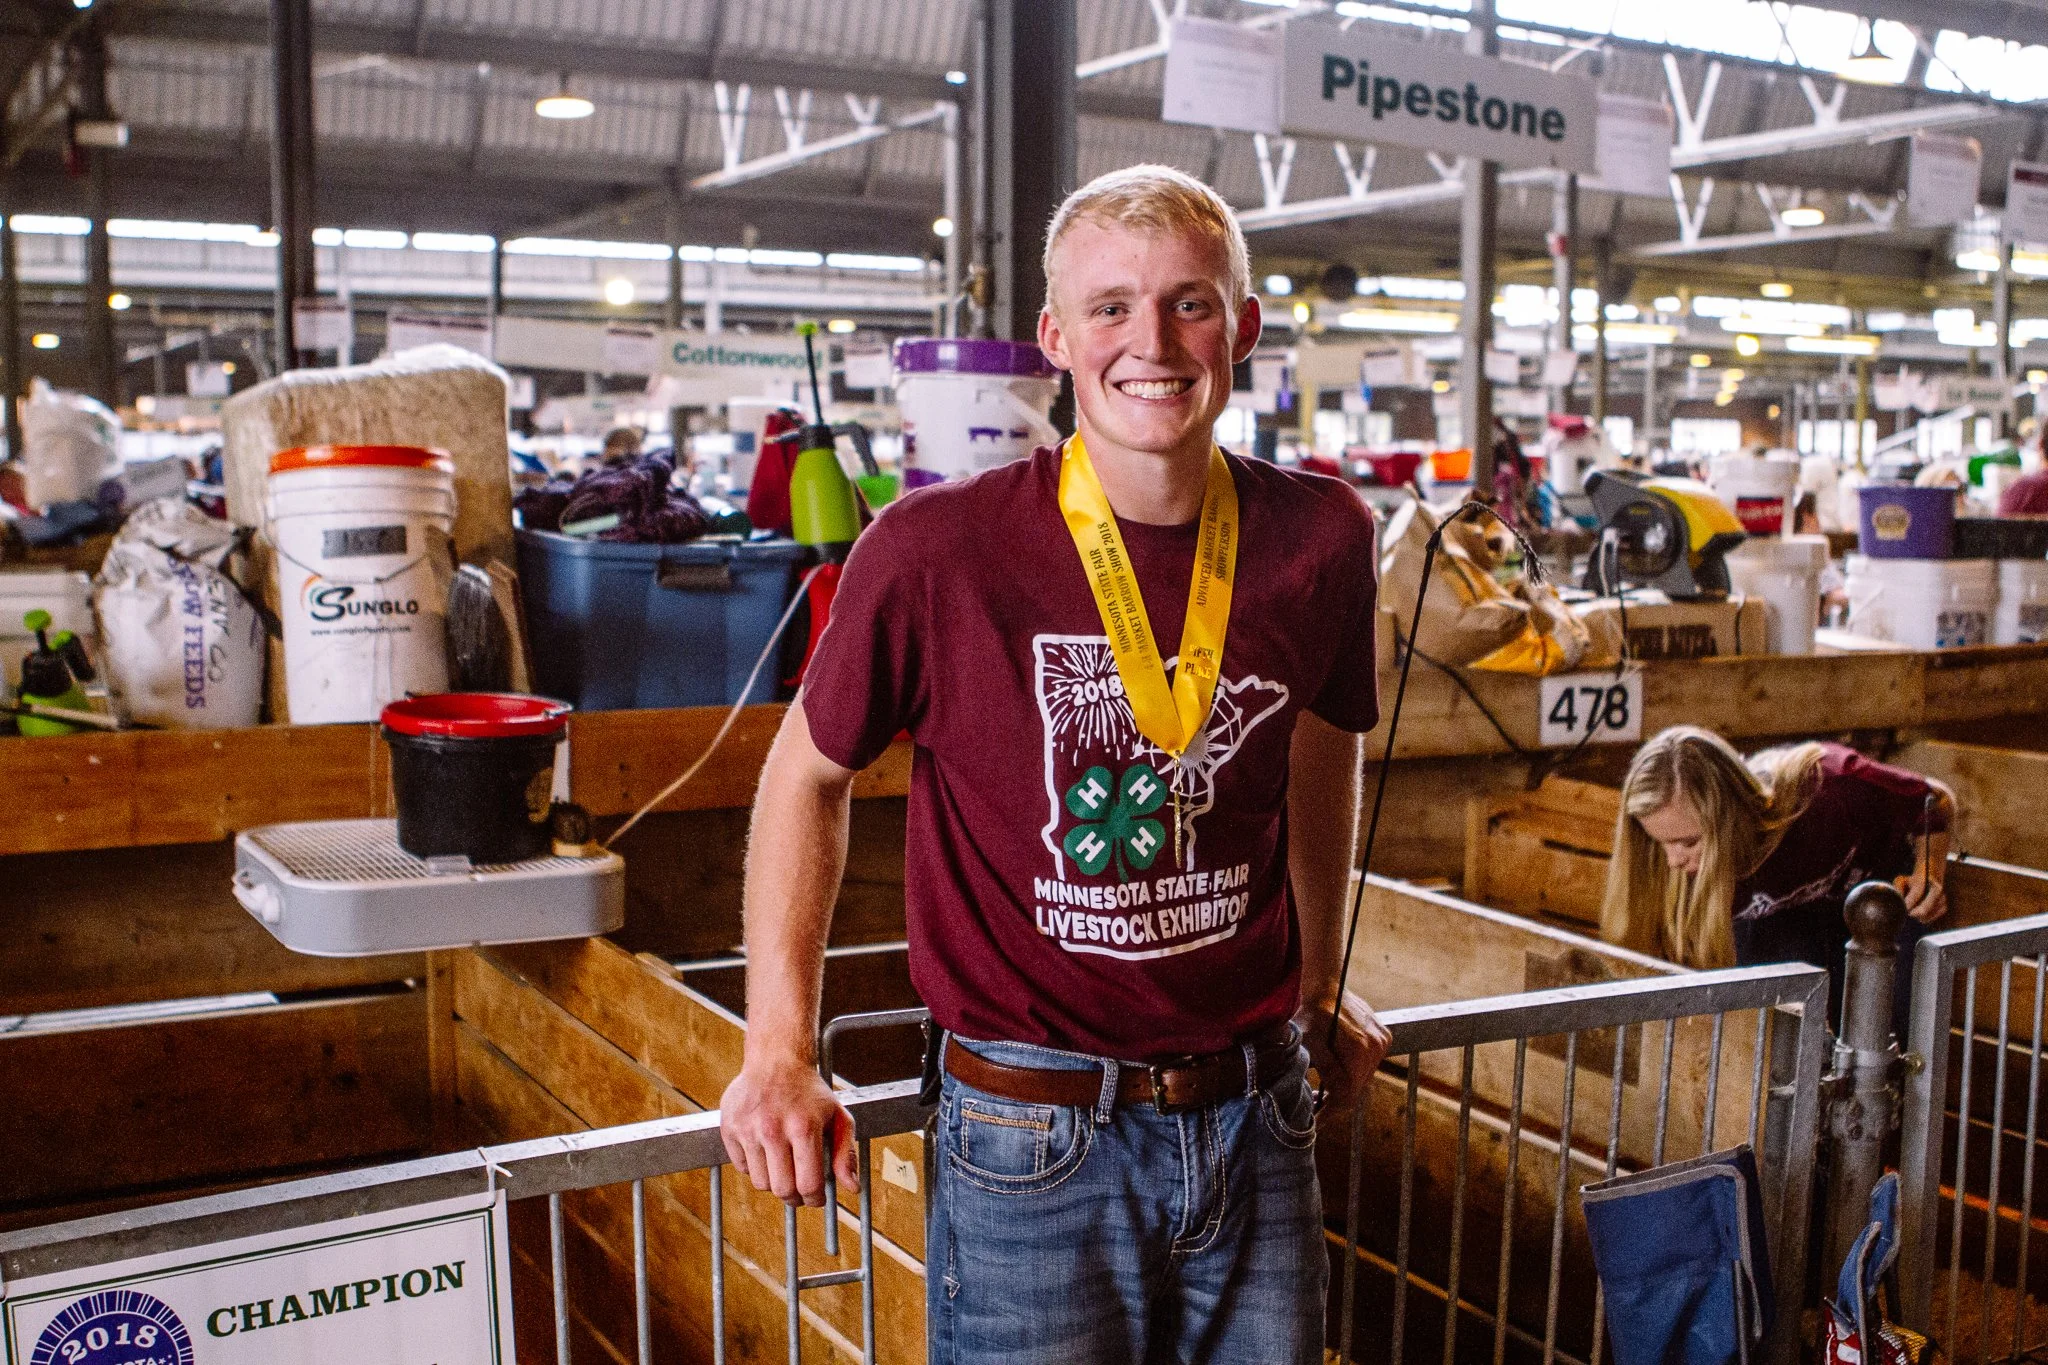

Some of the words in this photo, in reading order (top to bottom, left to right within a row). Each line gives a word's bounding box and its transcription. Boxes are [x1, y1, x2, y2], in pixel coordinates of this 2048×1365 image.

[1322, 54, 1567, 142] Pipestone
[1098, 521, 1114, 545] 2018
[1203, 524, 1218, 564] MARKET
[1215, 521, 1232, 581] SHOWPERSON
[1089, 548, 1106, 571] FAIR
[1106, 547, 1124, 573] SHOW
[1097, 570, 1115, 600] STATE
[1115, 574, 1137, 614] BARROW
[1196, 561, 1213, 608] ADVANCED
[1106, 599, 1132, 654] MINNESOTA
[1129, 615, 1149, 654] MARKET
[1071, 674, 1124, 706] 2018
[1548, 683, 1629, 732] 478
[1077, 777, 1108, 810] H
[1128, 774, 1157, 805] H
[1075, 831, 1106, 863] H
[1130, 826, 1156, 858] H
[1034, 877, 1151, 910] MINNESOTA
[1155, 872, 1209, 902] STATE
[1213, 863, 1250, 893] FAIR
[1036, 905, 1159, 945] LIVESTOCK
[1158, 892, 1250, 939] EXHIBITOR
[206, 1260, 466, 1338] CHAMPION
[61, 1322, 159, 1364] 2018
